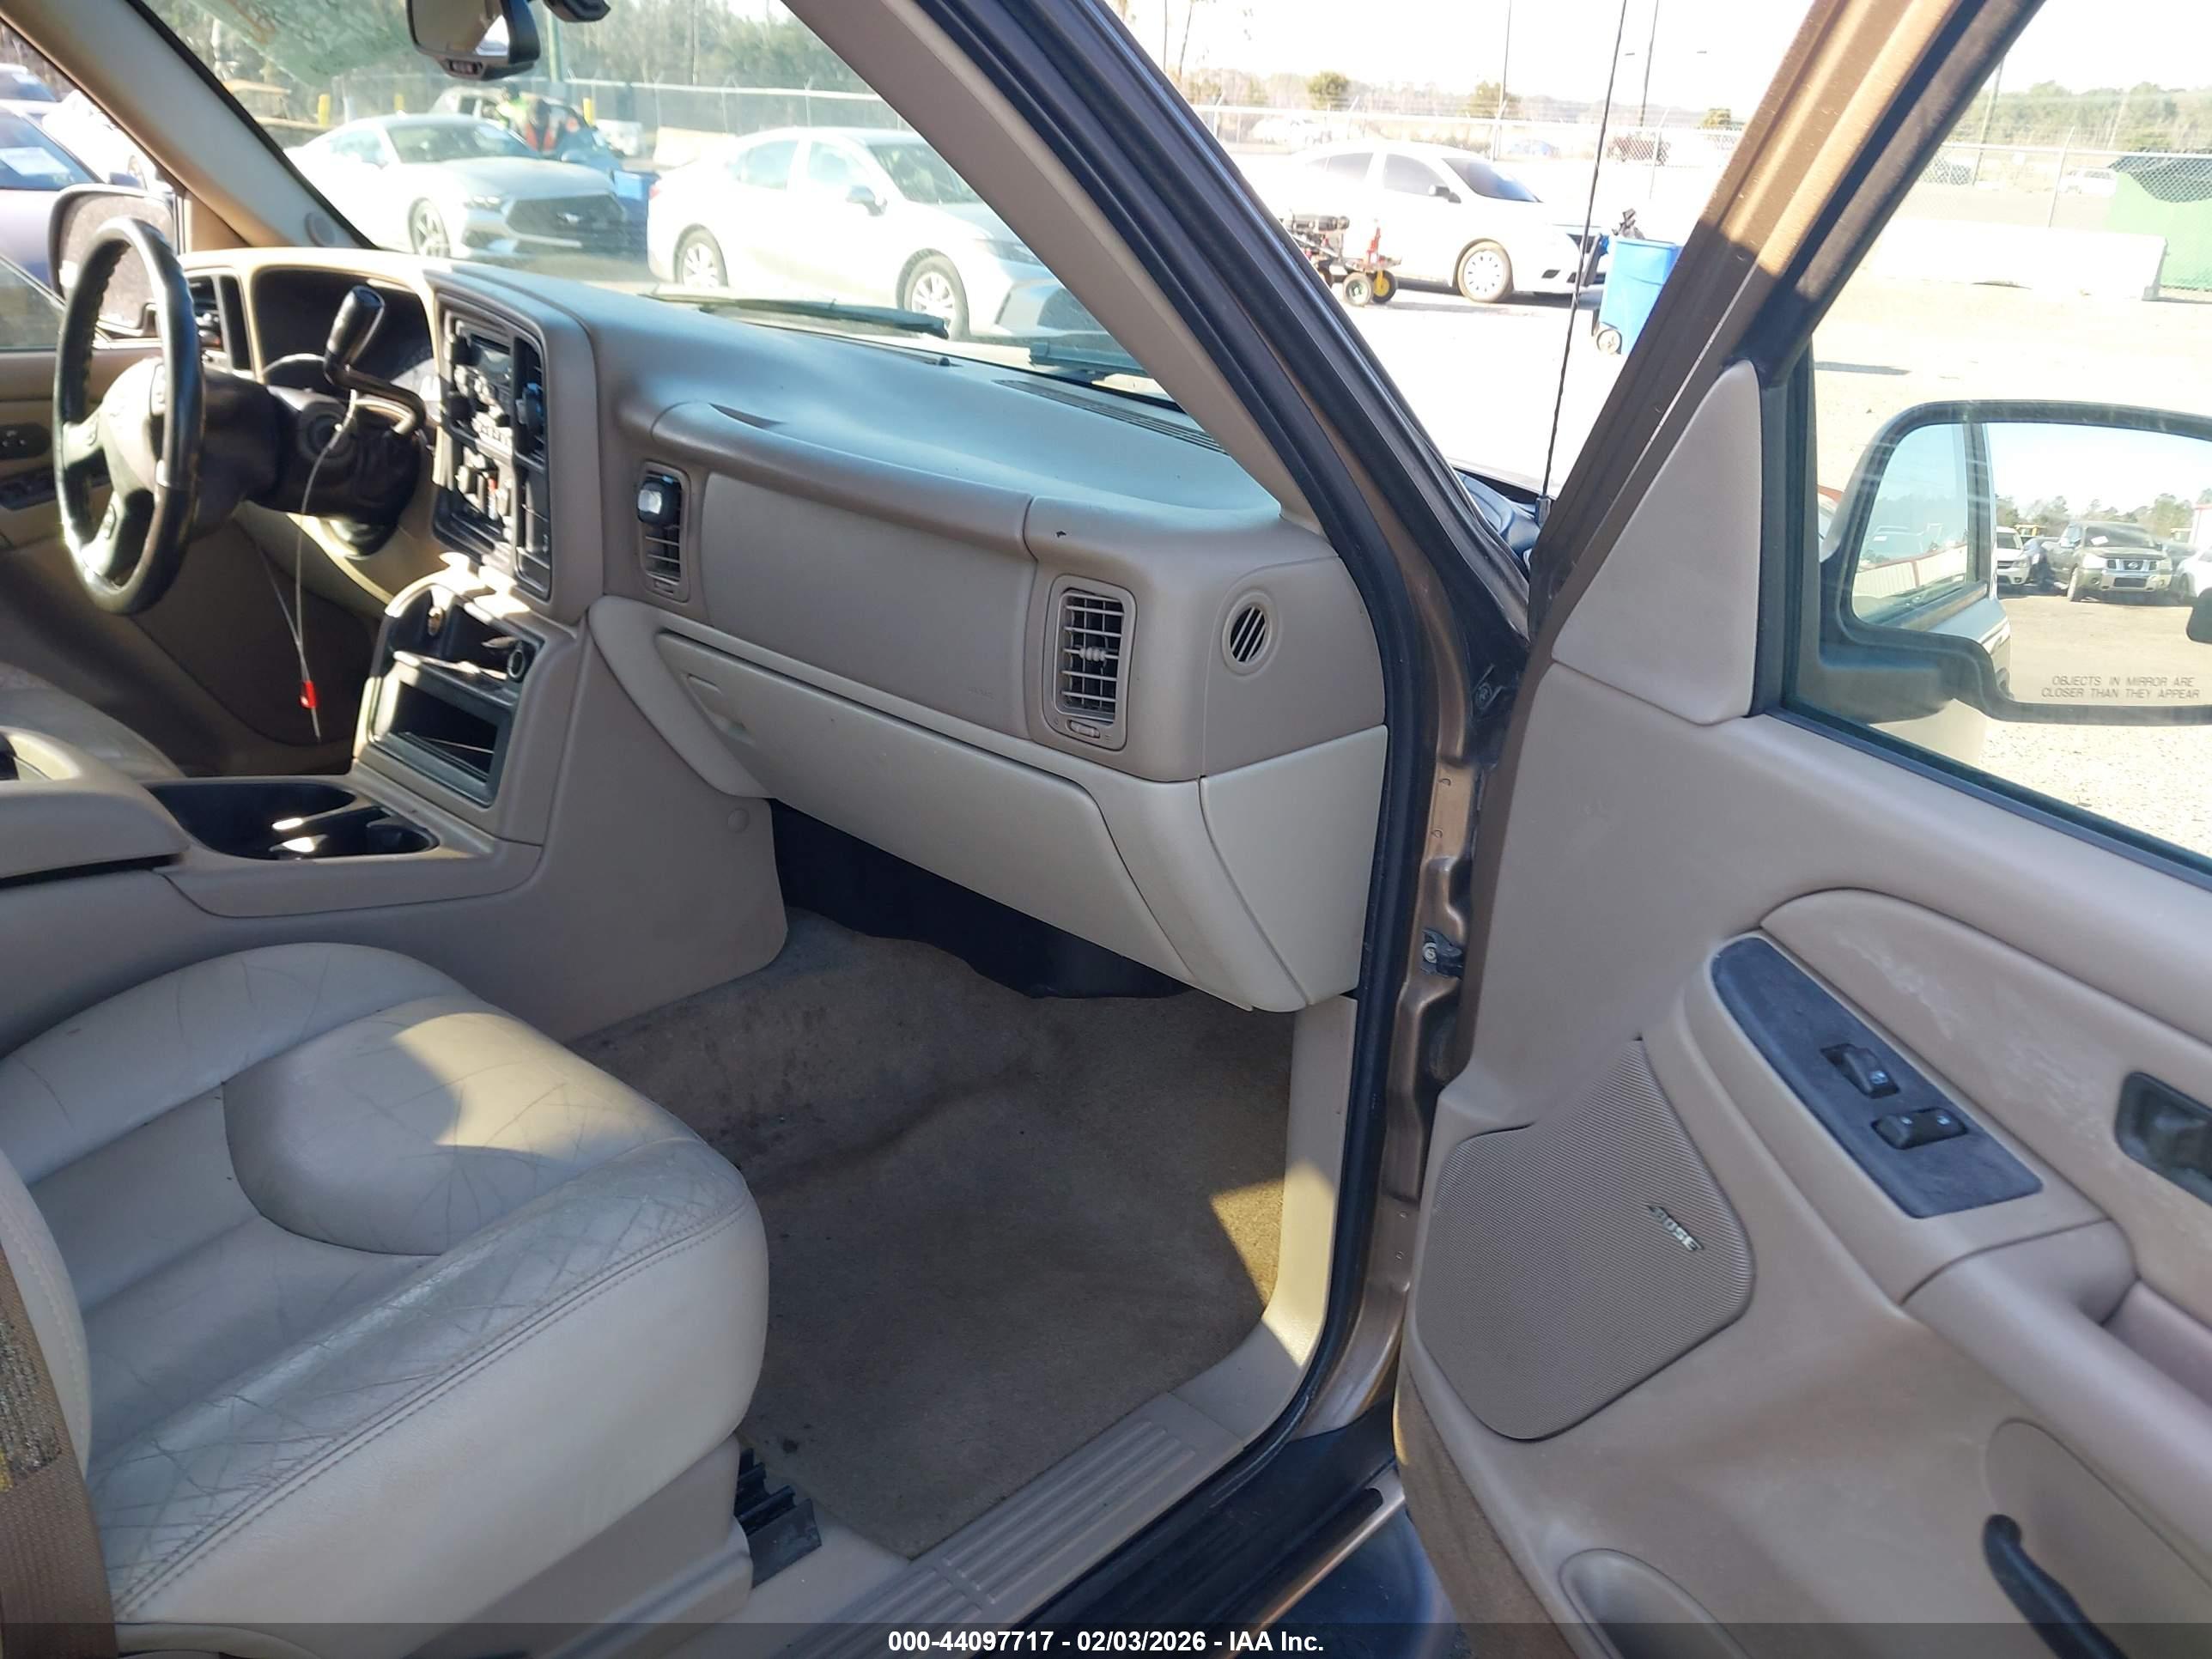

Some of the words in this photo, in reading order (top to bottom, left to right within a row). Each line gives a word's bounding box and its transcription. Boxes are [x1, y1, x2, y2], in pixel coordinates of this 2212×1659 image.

[2051, 675, 2101, 686] OBJECTS
[2109, 676, 2120, 686] IN
[2125, 676, 2168, 687] MIRROR
[2173, 677, 2195, 688] ARE
[2041, 687, 2085, 698] CLOSER
[2091, 688, 2118, 698] THAN
[2125, 688, 2151, 699] THEY
[2157, 689, 2200, 699] APPEAR
